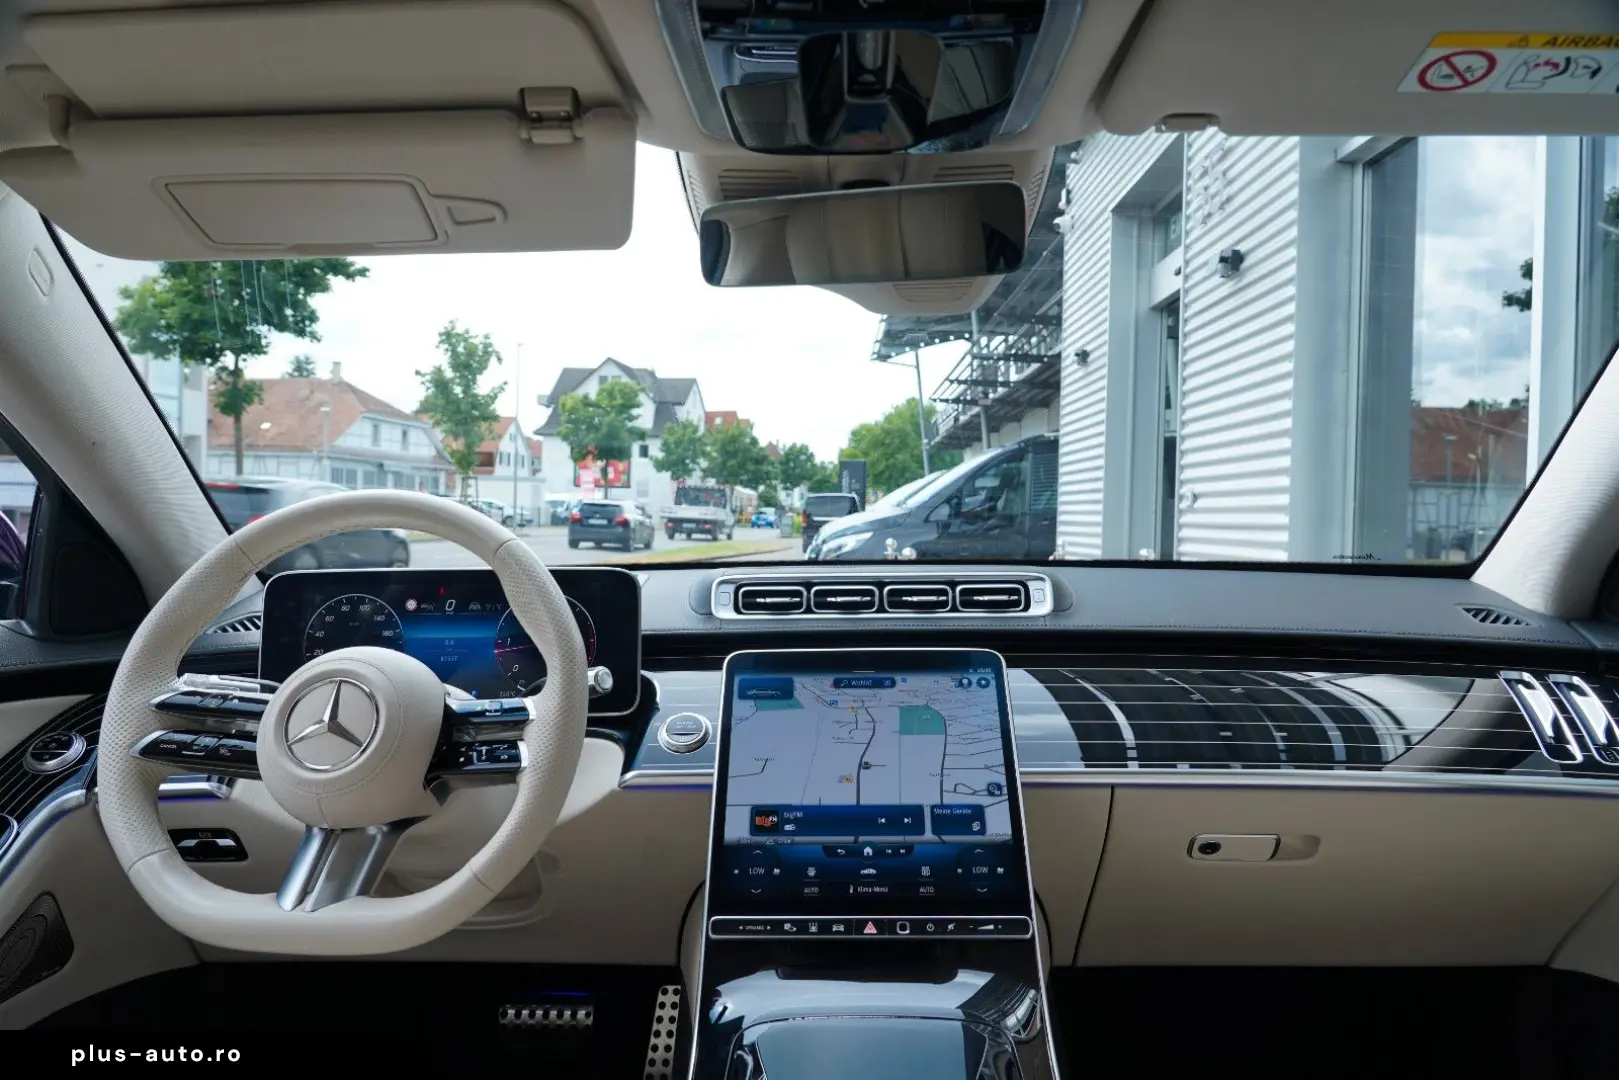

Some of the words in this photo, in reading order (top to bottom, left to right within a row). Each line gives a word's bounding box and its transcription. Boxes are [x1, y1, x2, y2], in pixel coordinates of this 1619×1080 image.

[445, 599, 456, 611] 0
[749, 867, 765, 875] LOW
[972, 866, 989, 874] LOW
